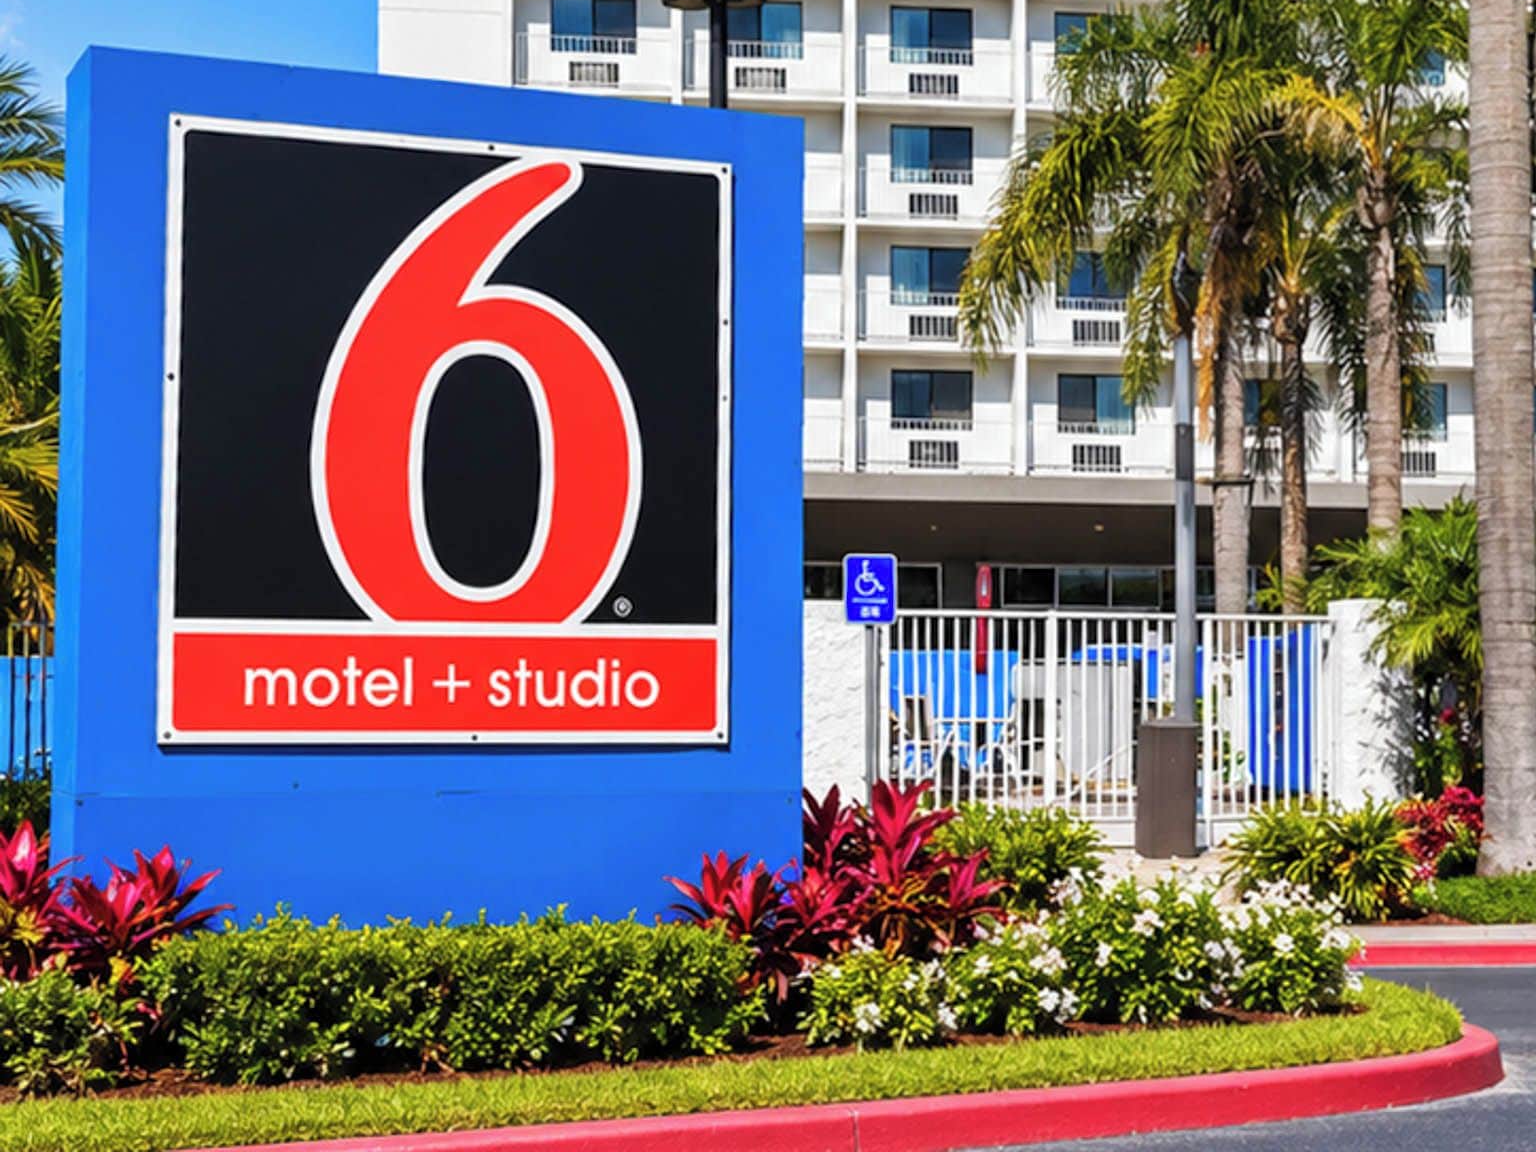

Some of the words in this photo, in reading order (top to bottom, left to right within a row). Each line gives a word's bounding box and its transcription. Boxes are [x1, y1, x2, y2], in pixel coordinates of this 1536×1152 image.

[311, 154, 644, 624] 6
[243, 655, 414, 707] motel
[487, 657, 661, 709] studio
